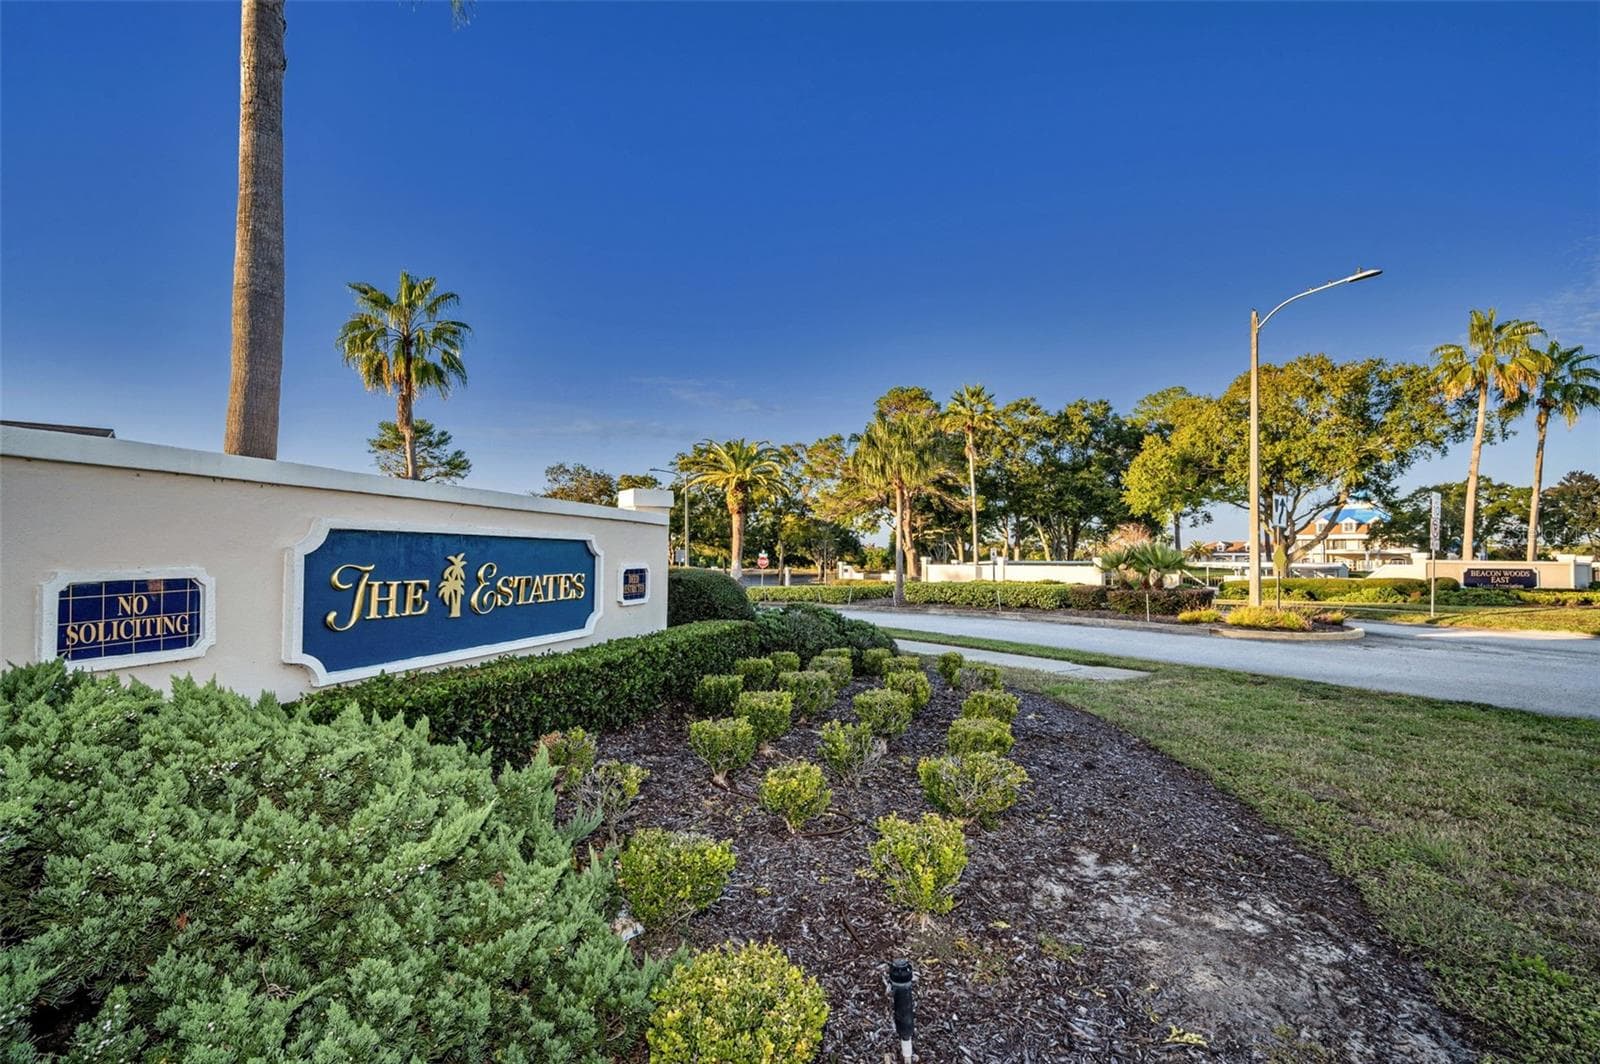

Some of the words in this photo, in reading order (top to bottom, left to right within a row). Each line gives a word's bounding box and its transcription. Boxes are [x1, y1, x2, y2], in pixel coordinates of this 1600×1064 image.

[1470, 569, 1502, 577] BEACON
[1503, 569, 1531, 577] WOODS
[1490, 576, 1510, 584] EAST
[117, 594, 149, 616] NO
[325, 563, 430, 632] THE
[470, 562, 586, 615] ESTATES
[65, 613, 191, 646] SOLICITING
